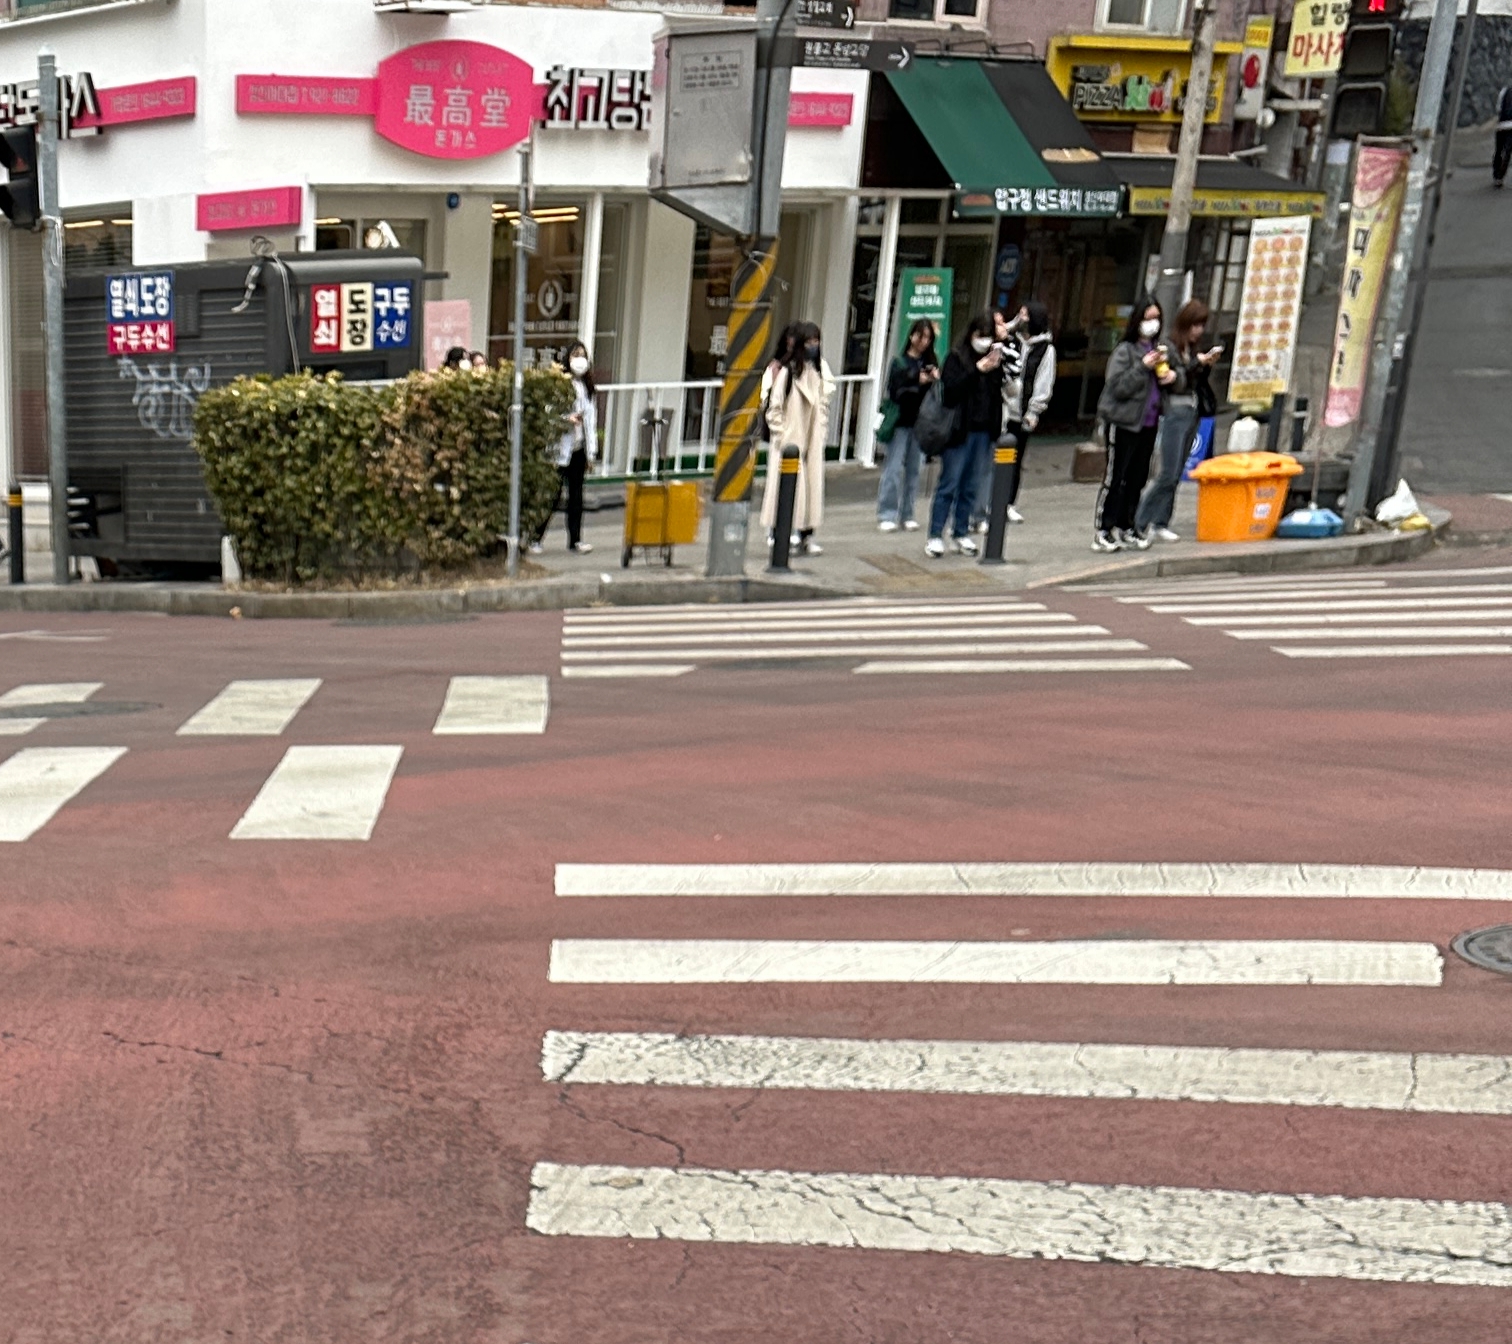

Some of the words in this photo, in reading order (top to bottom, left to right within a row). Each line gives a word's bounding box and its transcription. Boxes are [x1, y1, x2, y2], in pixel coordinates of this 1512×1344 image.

[403, 83, 511, 127] 最高堂
[546, 66, 652, 130] 최고당
[1073, 82, 1124, 110] PIZZA
[314, 289, 338, 346] 열쇠
[347, 289, 368, 346] 도장
[374, 287, 410, 317] 구두
